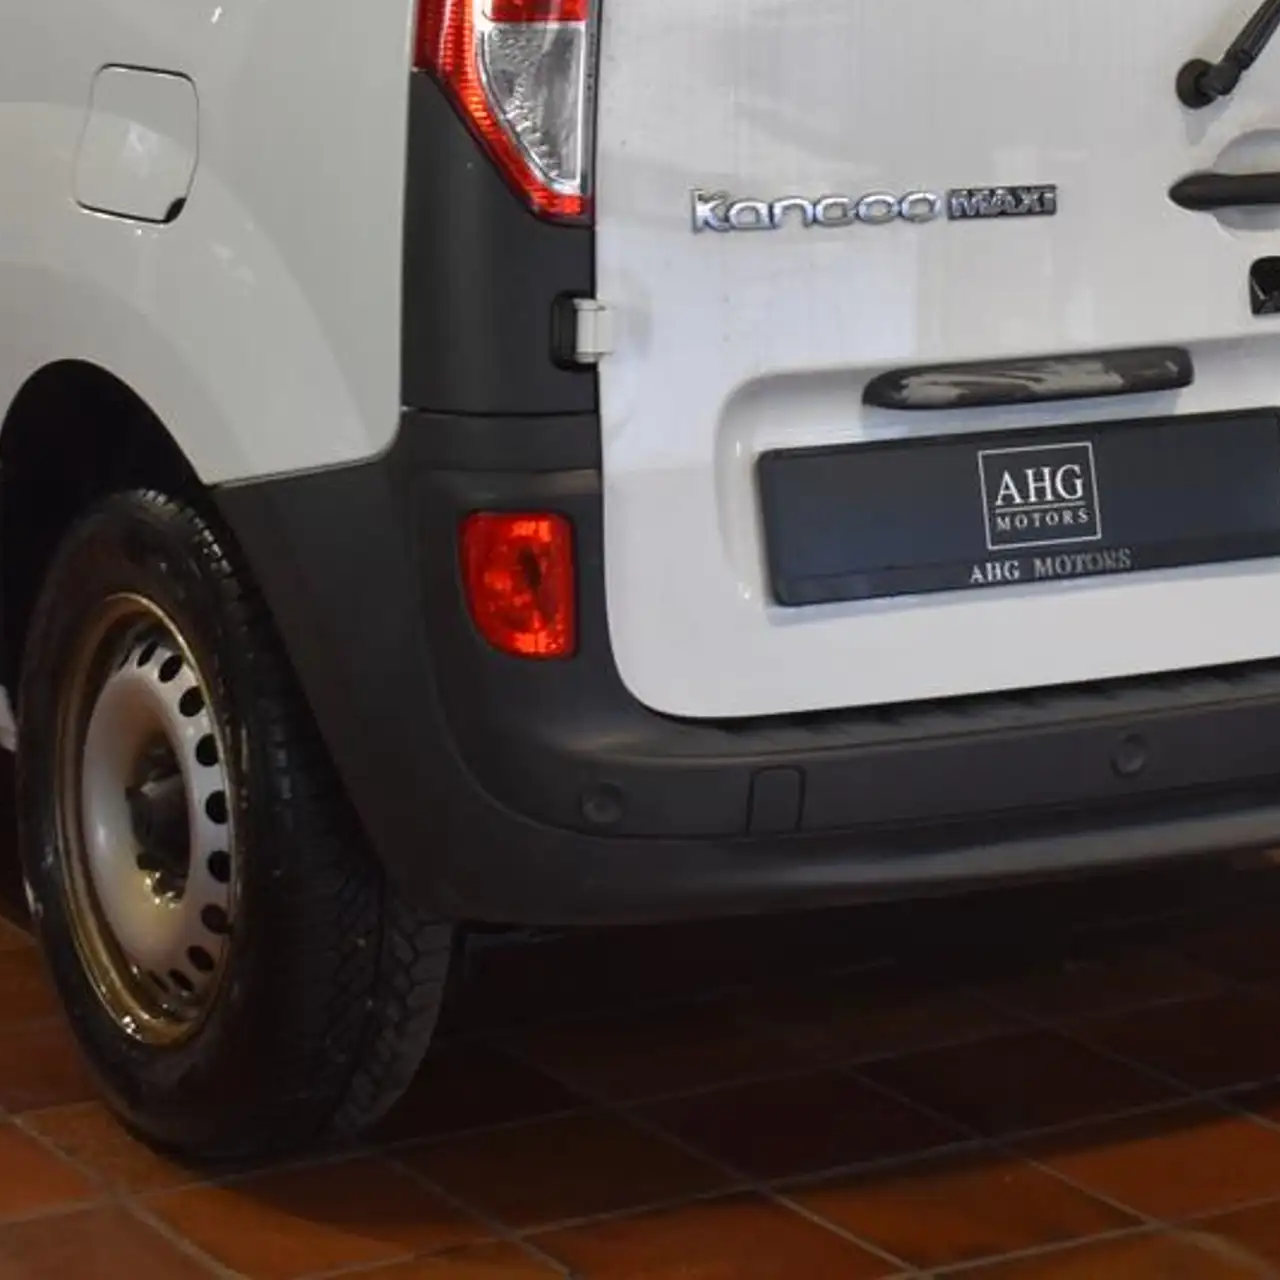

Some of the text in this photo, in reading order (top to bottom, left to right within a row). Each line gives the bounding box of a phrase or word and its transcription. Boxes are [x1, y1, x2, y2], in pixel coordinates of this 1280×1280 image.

[949, 185, 1057, 220] MAXI
[995, 464, 1085, 506] AHG
[995, 508, 1090, 532] MOTORS
[969, 548, 1132, 584] AHG MOTORS
